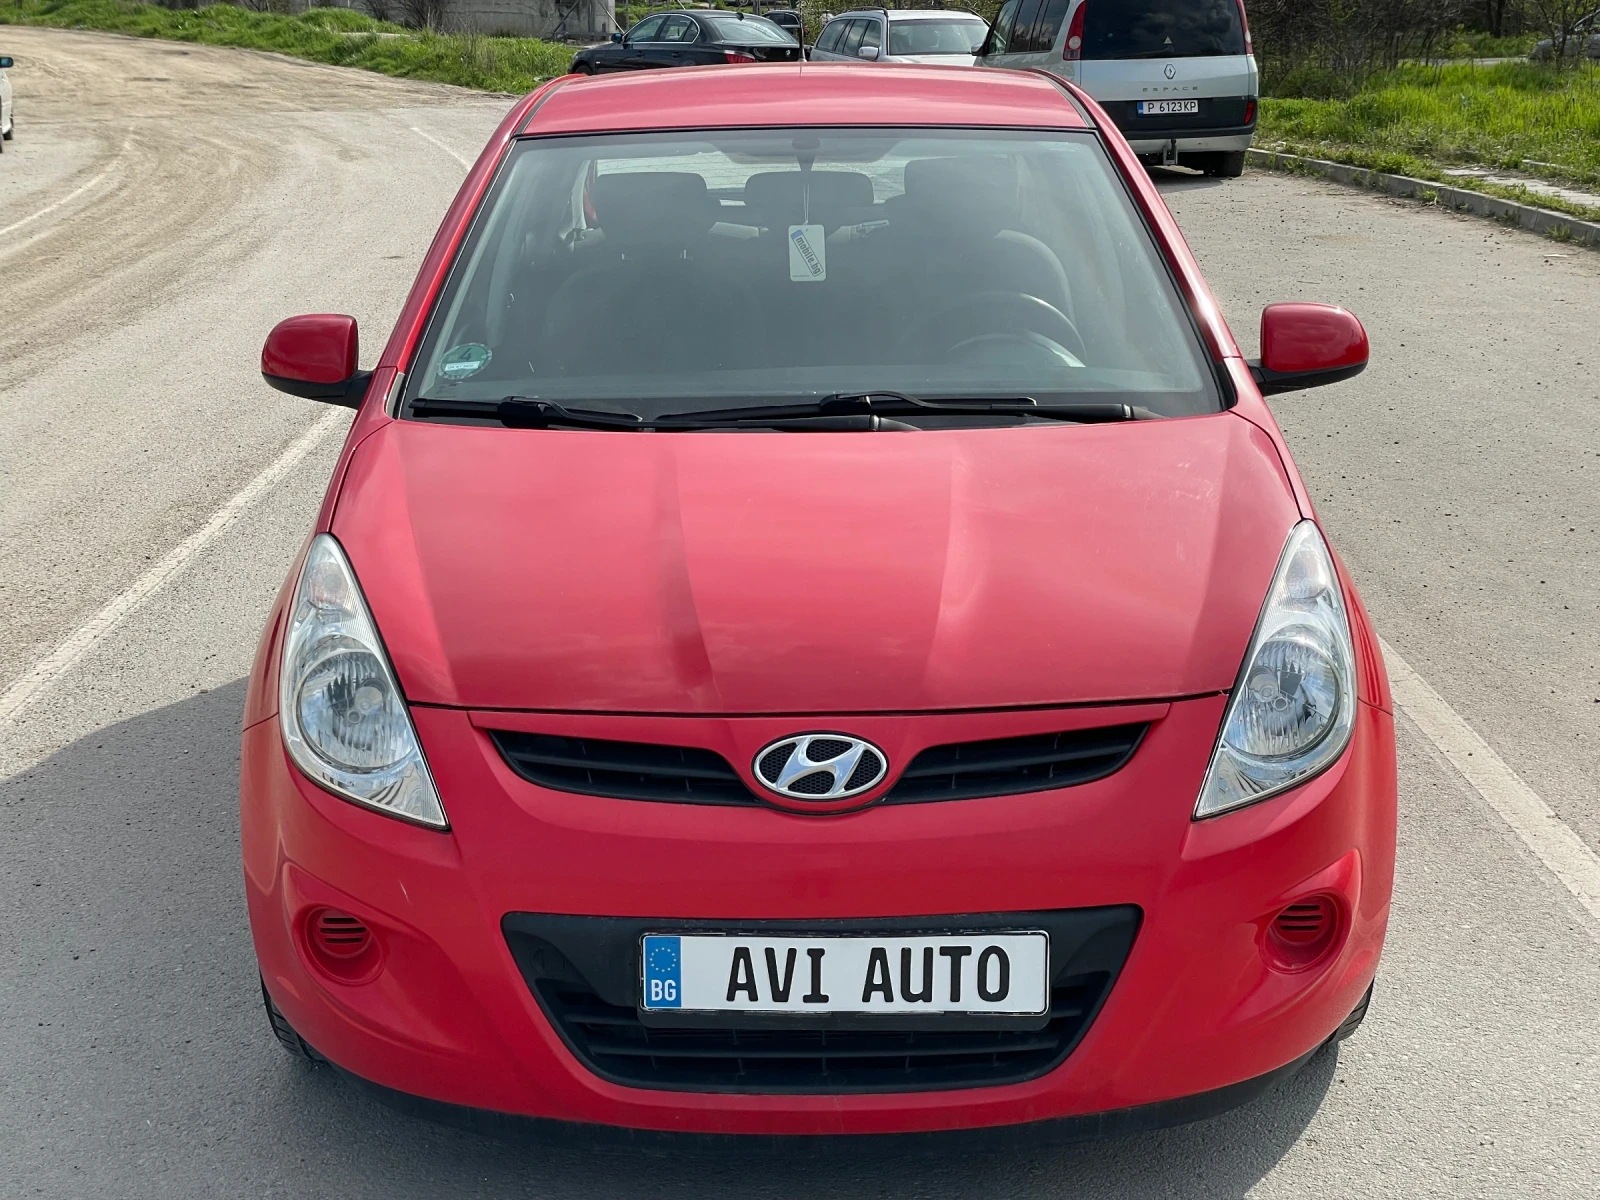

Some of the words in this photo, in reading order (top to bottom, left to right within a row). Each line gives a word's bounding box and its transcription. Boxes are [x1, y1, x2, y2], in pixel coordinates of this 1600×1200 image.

[1148, 102, 1154, 112] P
[795, 236, 821, 275] mobile.bg
[459, 347, 472, 360] 4
[726, 946, 830, 1004] AVI
[861, 945, 1011, 1004] AUTO
[651, 979, 677, 1002] BG
